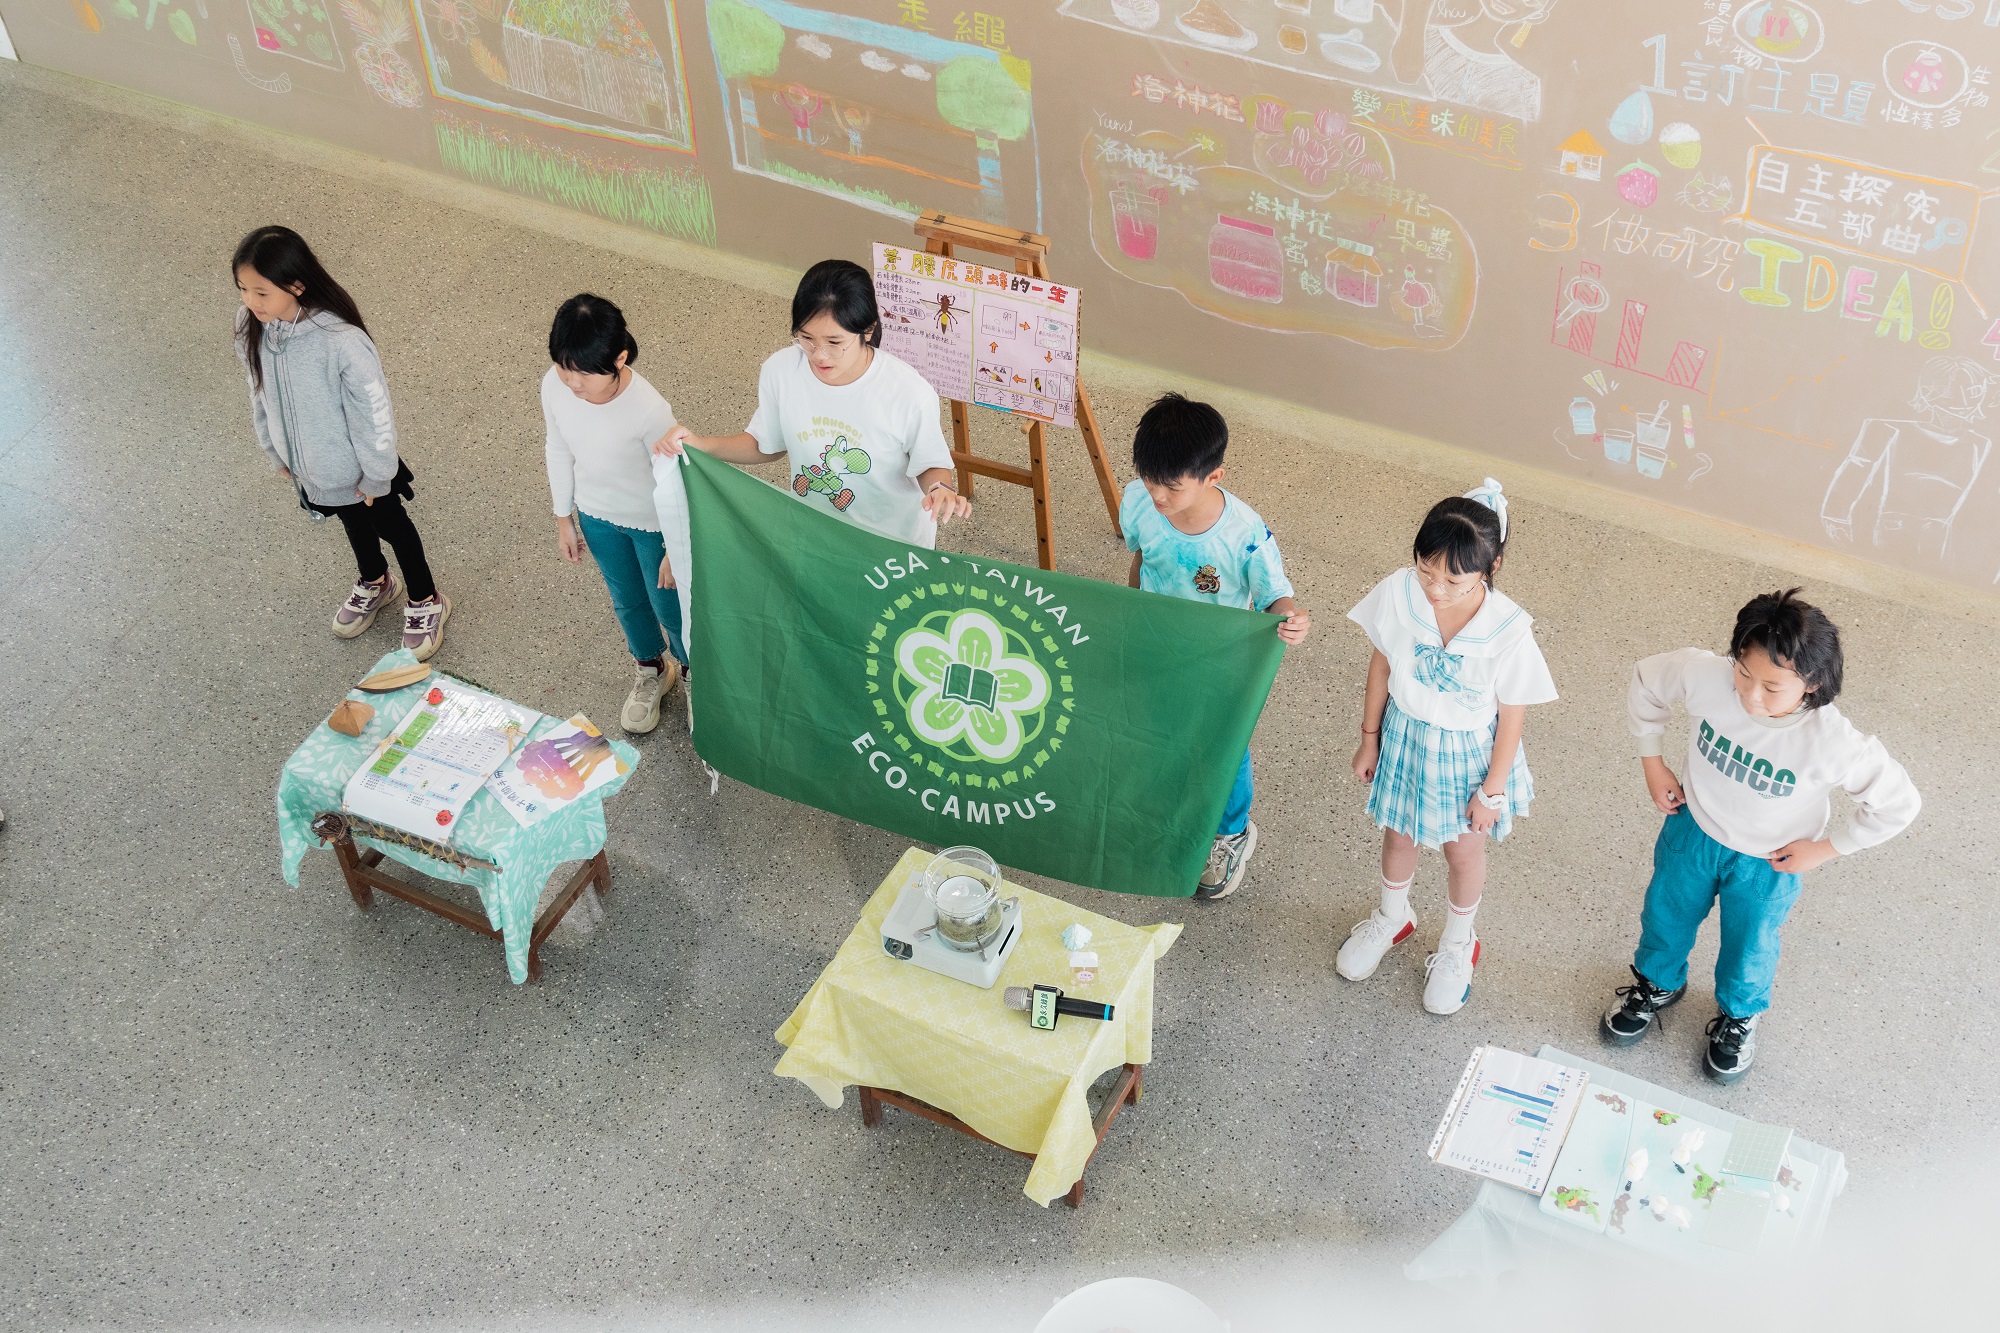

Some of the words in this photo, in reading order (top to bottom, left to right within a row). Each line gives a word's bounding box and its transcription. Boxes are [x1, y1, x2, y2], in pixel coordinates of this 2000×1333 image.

[1639, 34, 1677, 97] 1
[1351, 90, 1519, 155] 變成美味的美食
[1755, 153, 1941, 224] 自主探究
[1785, 198, 1922, 256] 五部曲
[1738, 237, 1956, 352] IDEA!
[977, 385, 1046, 415] 完全變態
[864, 551, 930, 590] USA
[963, 560, 1090, 647] TAIWAN
[851, 731, 1057, 825] ECO-CAMPUS
